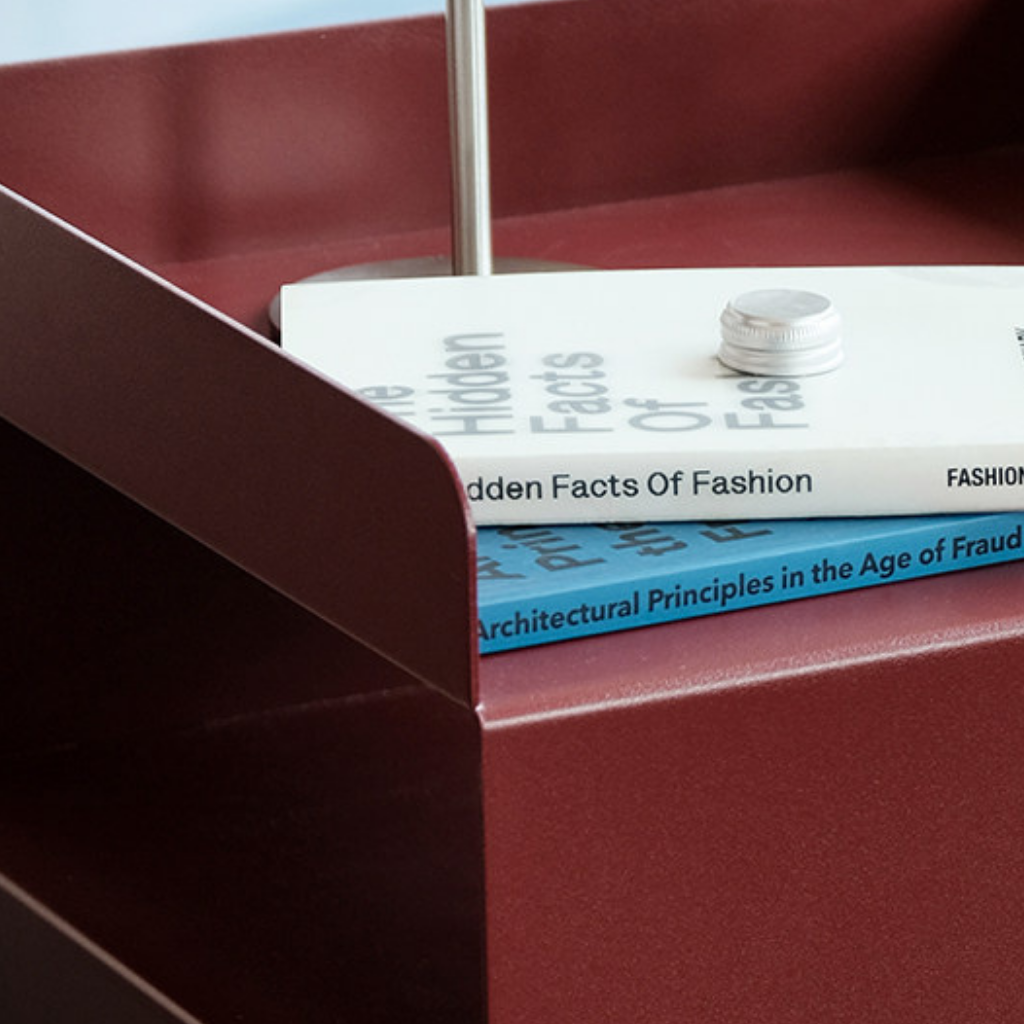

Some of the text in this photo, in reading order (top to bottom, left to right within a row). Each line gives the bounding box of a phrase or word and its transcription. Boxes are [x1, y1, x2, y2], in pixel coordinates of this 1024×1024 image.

[426, 332, 516, 436] Hidden
[529, 351, 614, 434] Facts
[622, 397, 713, 433] Of
[723, 379, 810, 430] Fas
[467, 468, 813, 501] dden Facts Of Fashion
[477, 524, 1023, 642] Architectural Principles in the Age of Fraud
